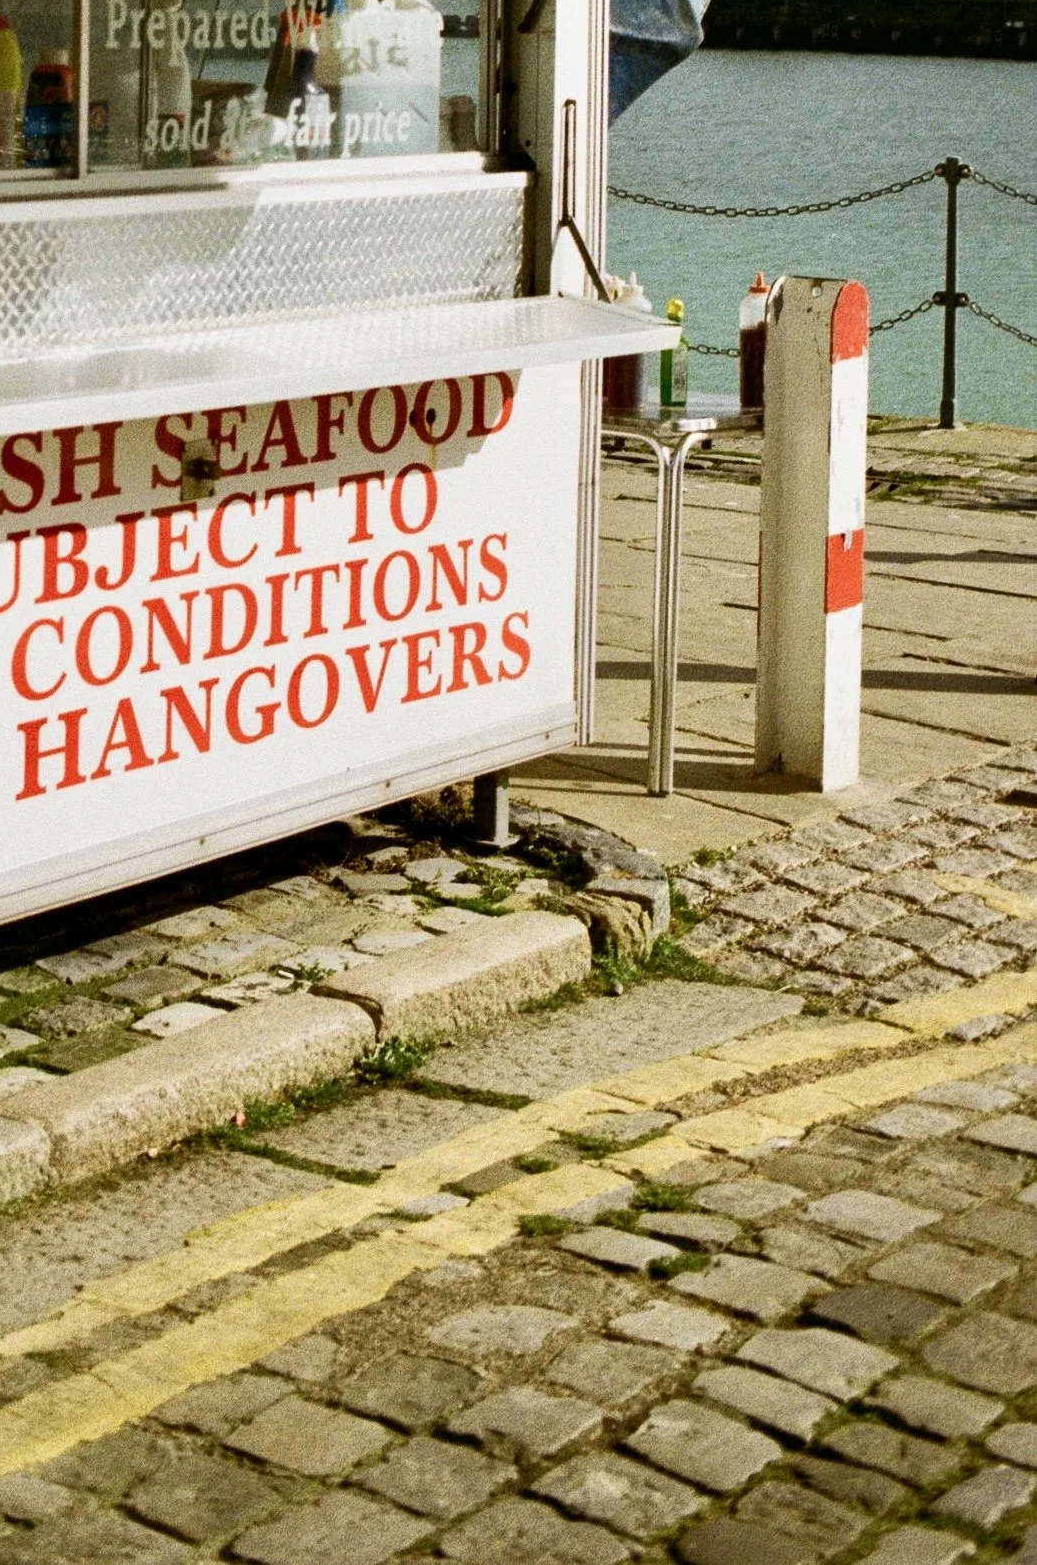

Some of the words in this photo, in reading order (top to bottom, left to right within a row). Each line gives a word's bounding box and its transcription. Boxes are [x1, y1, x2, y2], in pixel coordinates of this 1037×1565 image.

[144, 100, 212, 152] sold
[284, 95, 336, 147] fair
[341, 99, 413, 158] price
[151, 370, 514, 488] SEAFOOD
[338, 462, 439, 544] TO
[11, 533, 509, 702] CONDITIONS
[16, 611, 532, 803] HANGOVERS
